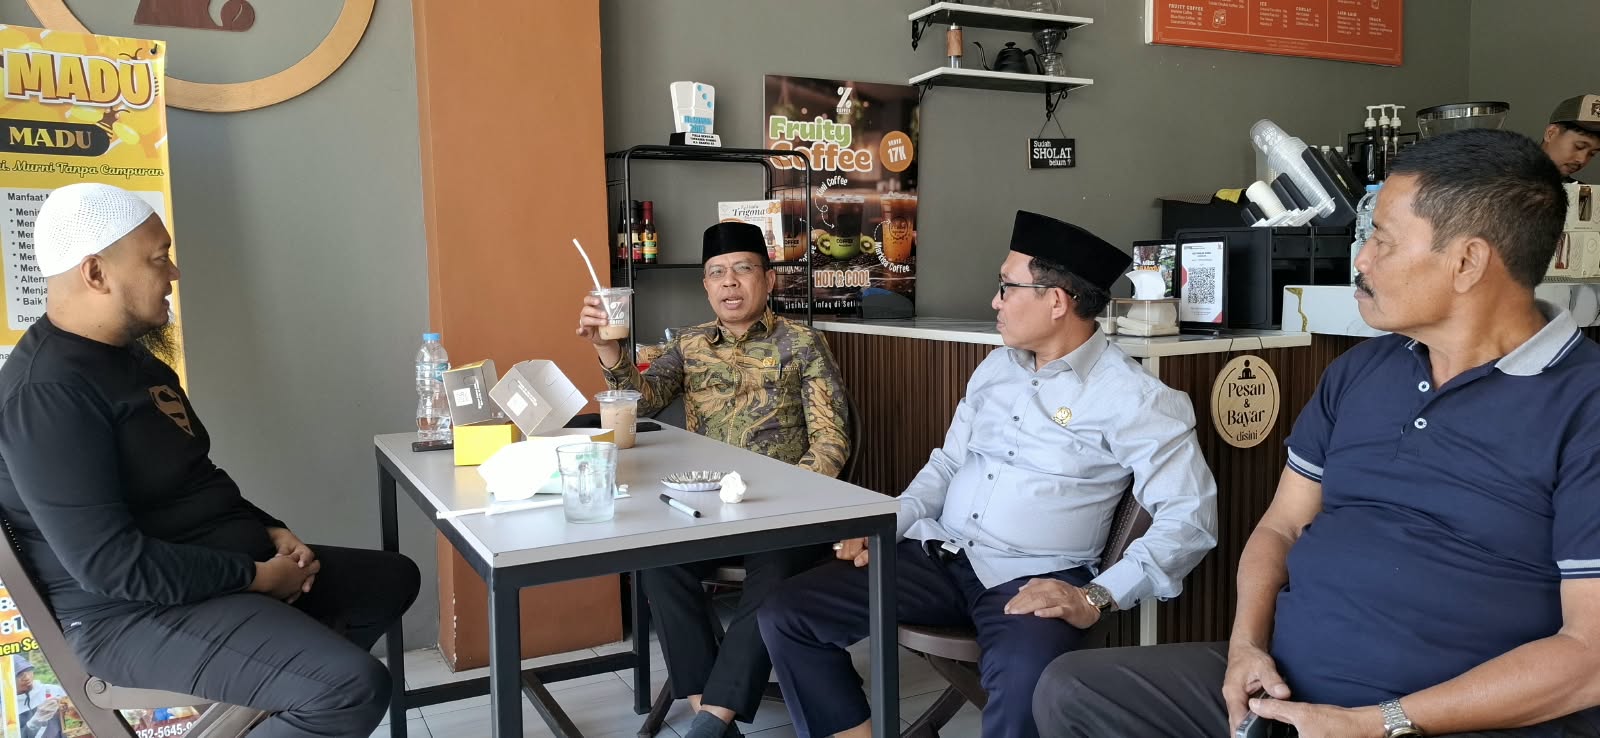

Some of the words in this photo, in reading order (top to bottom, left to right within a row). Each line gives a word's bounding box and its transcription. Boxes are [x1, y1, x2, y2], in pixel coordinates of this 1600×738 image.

[5, 49, 154, 109] MADU
[9, 126, 92, 149] MADU
[769, 115, 852, 148] Fruity
[769, 140, 873, 172] Coffee
[887, 145, 907, 163] 17K
[1033, 147, 1072, 159] SHOLAT
[13, 160, 56, 173] Murni
[56, 163, 99, 179] Tanpa
[100, 164, 164, 179] Campuran
[7, 192, 44, 202] Manfaat
[732, 208, 765, 218] Trigona
[814, 269, 834, 288] HOT
[834, 270, 845, 288] &
[845, 269, 871, 287] COOL
[23, 297, 43, 306] Baik
[1228, 383, 1265, 397] Pesan
[1243, 398, 1250, 408] &
[1227, 410, 1265, 427] Bayar
[1236, 430, 1258, 441] disini
